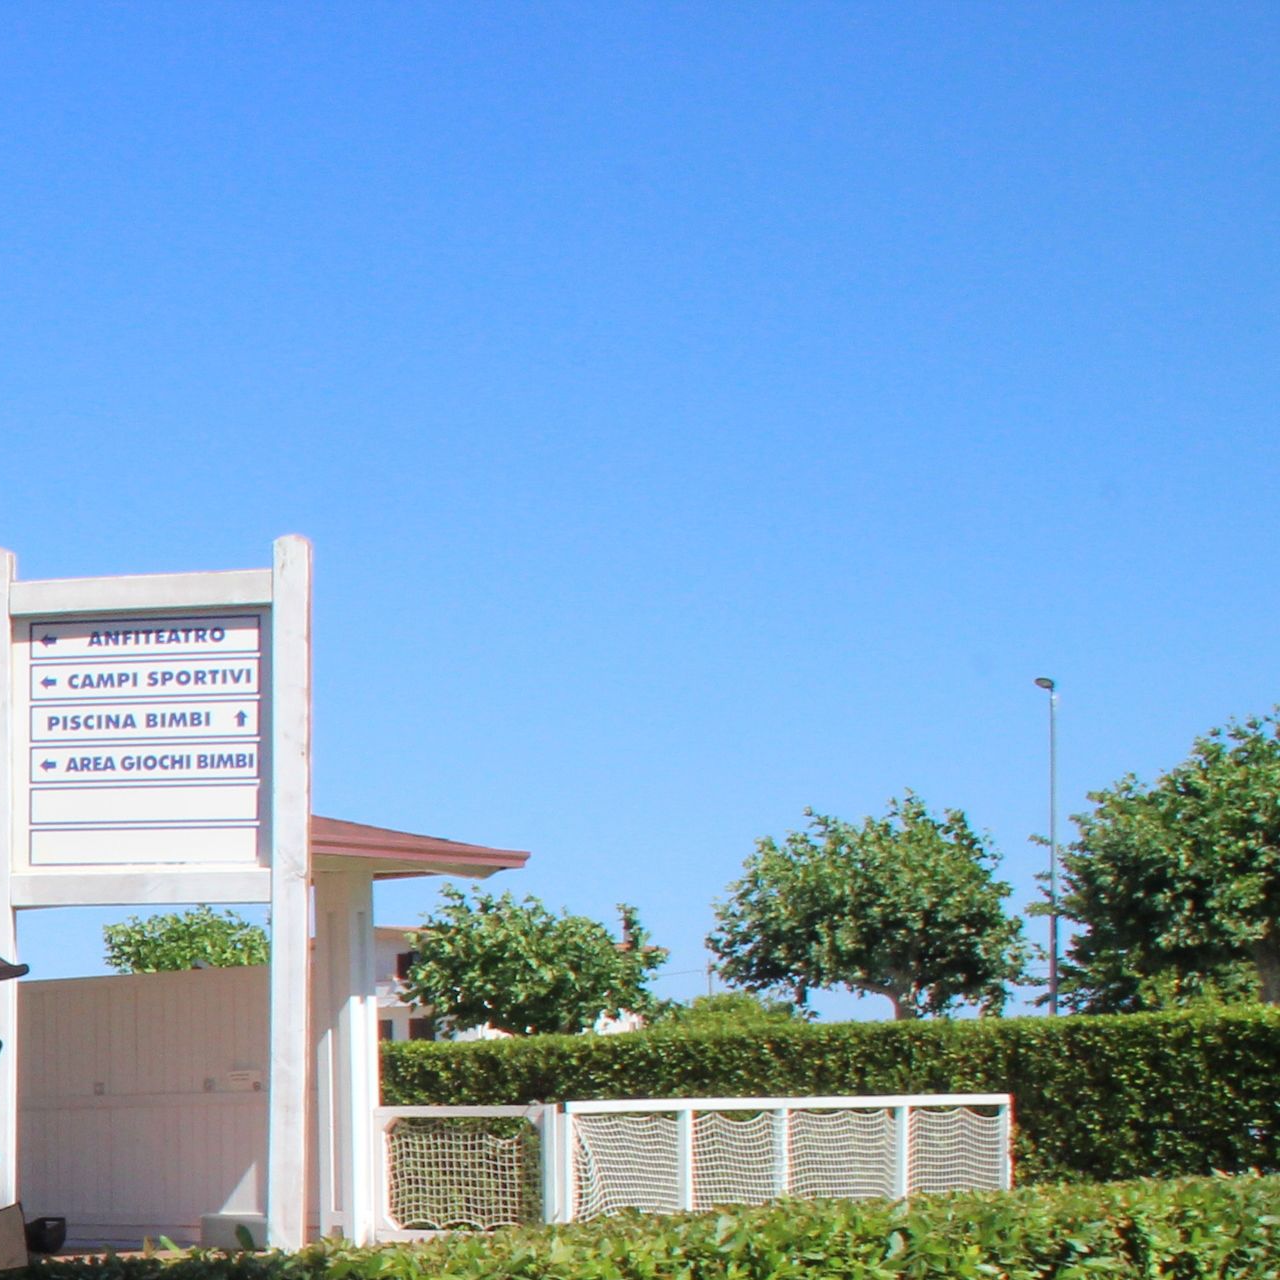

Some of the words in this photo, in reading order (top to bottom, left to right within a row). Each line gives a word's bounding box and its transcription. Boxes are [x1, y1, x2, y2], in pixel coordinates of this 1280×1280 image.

[88, 626, 225, 647] ANFITEATRO
[67, 672, 138, 689] CAMPI
[146, 668, 252, 687] SPORTIVI
[47, 713, 137, 731] PISCINA
[145, 711, 211, 728] BIMBI
[65, 756, 116, 772] AREA
[120, 755, 191, 771] GIOCHI
[196, 753, 254, 769] BIMBI
